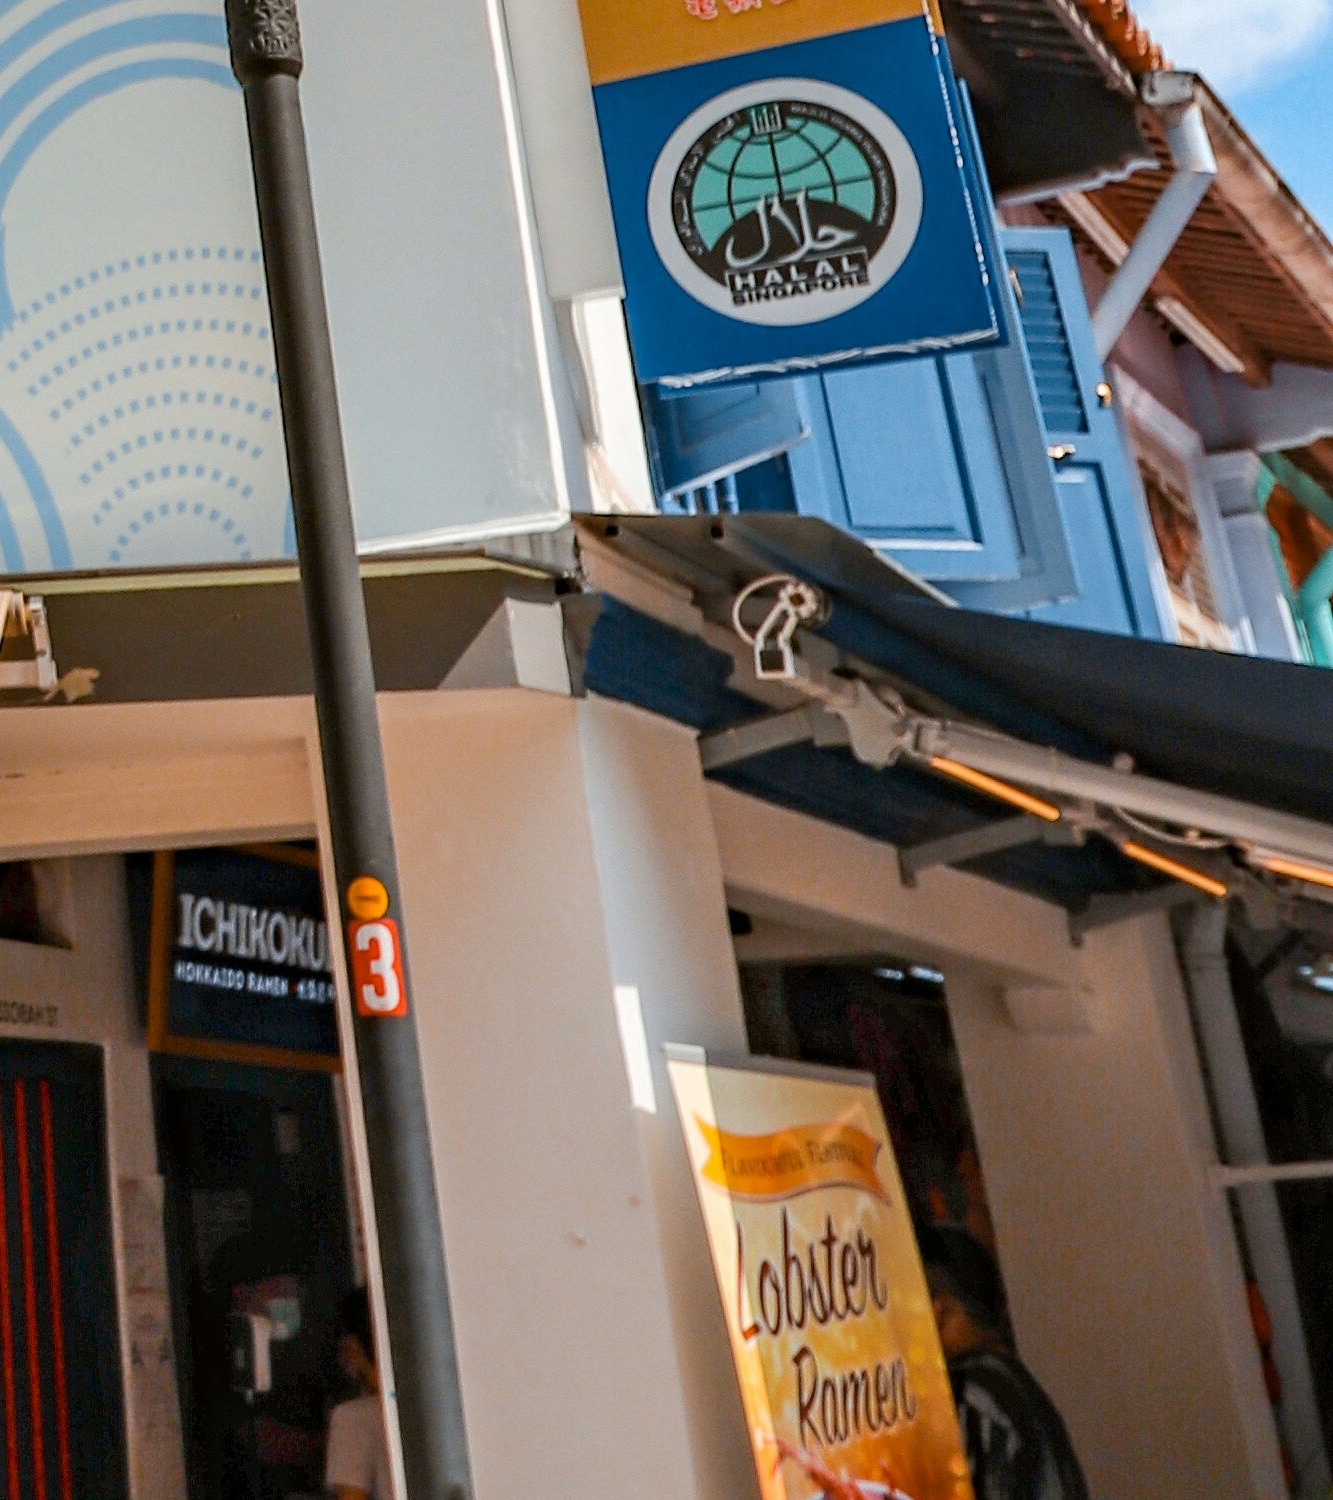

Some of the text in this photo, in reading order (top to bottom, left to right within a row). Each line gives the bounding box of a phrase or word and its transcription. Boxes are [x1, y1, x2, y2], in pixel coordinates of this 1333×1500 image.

[732, 273, 871, 307] SINGAPORE
[735, 256, 862, 292] HALAL
[178, 893, 335, 972] ICHIKOKU
[355, 922, 401, 1012] 3
[174, 960, 245, 991] HOKKAIDO
[247, 971, 289, 998] RAMEN
[735, 1203, 888, 1342] Lobster
[792, 1345, 917, 1450] Ramen
